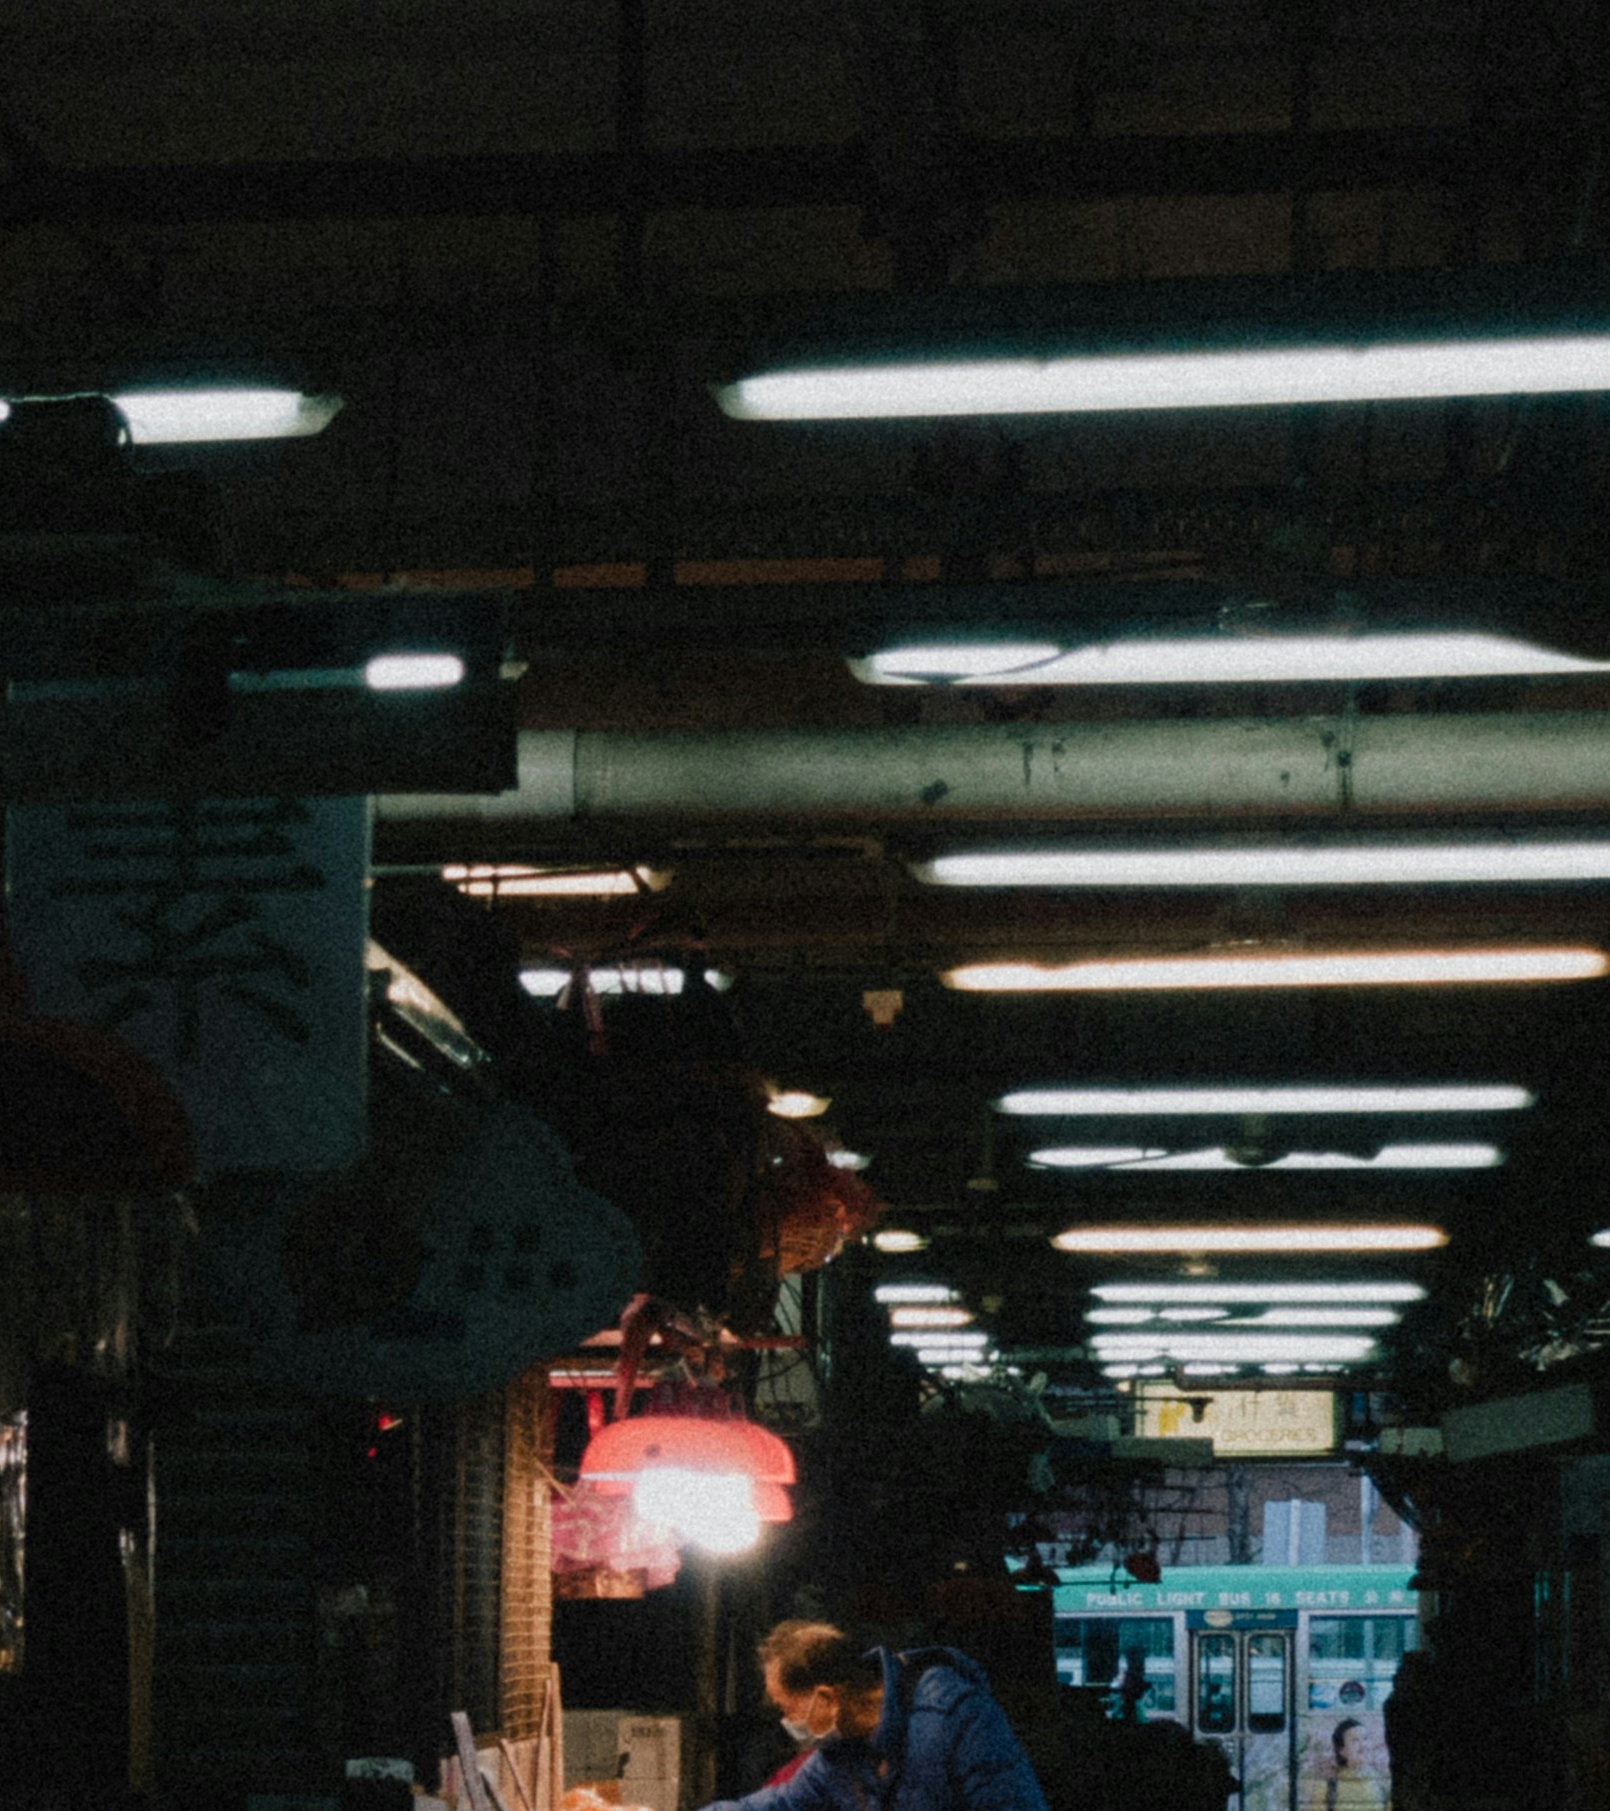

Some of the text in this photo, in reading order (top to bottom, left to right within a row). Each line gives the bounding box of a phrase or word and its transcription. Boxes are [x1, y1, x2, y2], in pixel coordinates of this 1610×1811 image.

[50, 802, 326, 1063] 素
[1086, 1592, 1144, 1606] PUBLIC
[1157, 1592, 1205, 1606] LIGHT
[1219, 1592, 1252, 1606] BUS
[1297, 1591, 1350, 1606] SEATS
